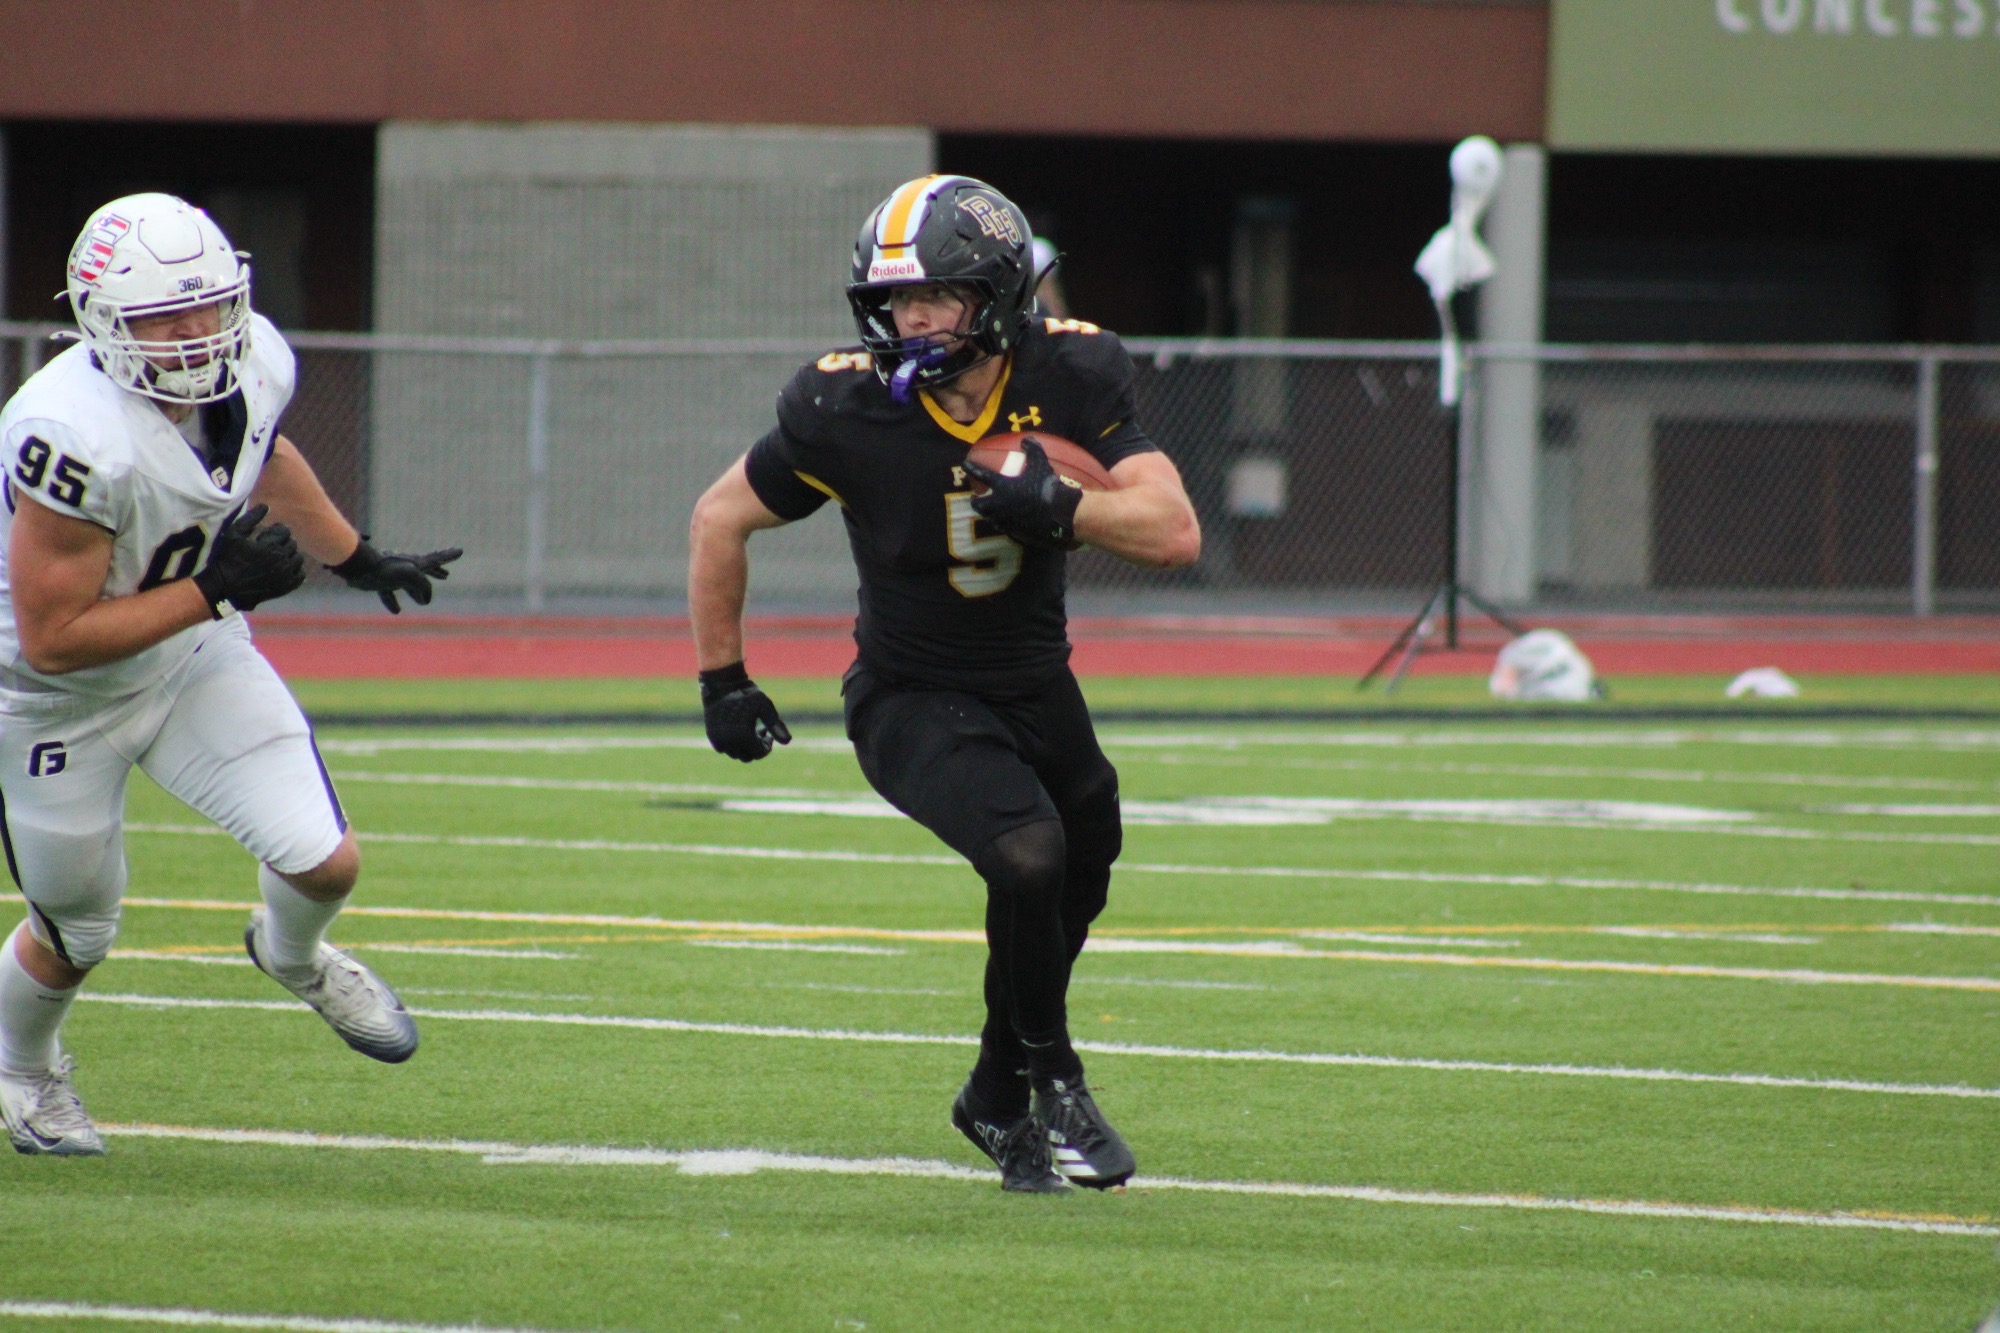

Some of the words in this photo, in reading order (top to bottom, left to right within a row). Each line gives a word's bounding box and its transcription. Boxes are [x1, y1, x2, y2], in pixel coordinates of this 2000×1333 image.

[1715, 0, 2000, 37] CONCES
[178, 276, 203, 293] 360
[872, 263, 915, 277] Riddell
[15, 434, 91, 508] 95
[944, 491, 1024, 599] 5
